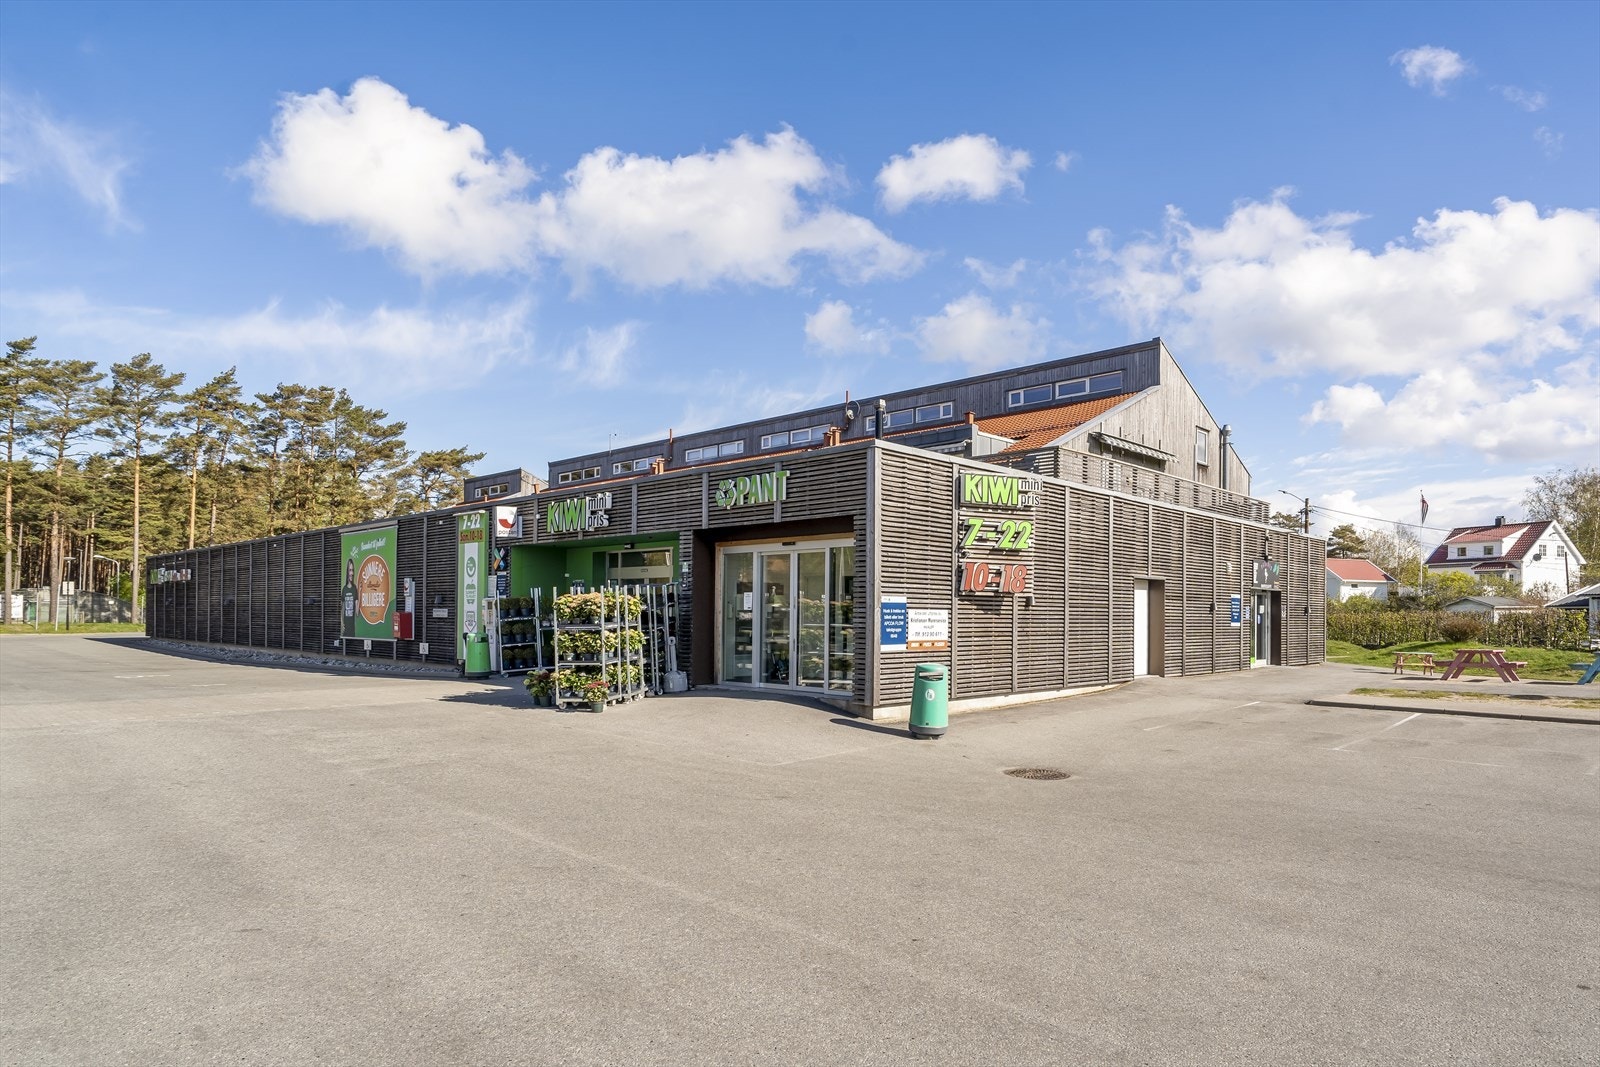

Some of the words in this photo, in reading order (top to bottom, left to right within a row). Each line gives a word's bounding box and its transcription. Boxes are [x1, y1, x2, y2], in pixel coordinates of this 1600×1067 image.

[737, 474, 788, 506] PANT
[964, 474, 1018, 505] KIWI
[1020, 478, 1043, 491] mini
[588, 493, 609, 510] mini
[1020, 493, 1040, 507] pris
[547, 498, 586, 533] KIWI
[588, 511, 606, 530] pris
[361, 592, 385, 607] BILLIGERE
